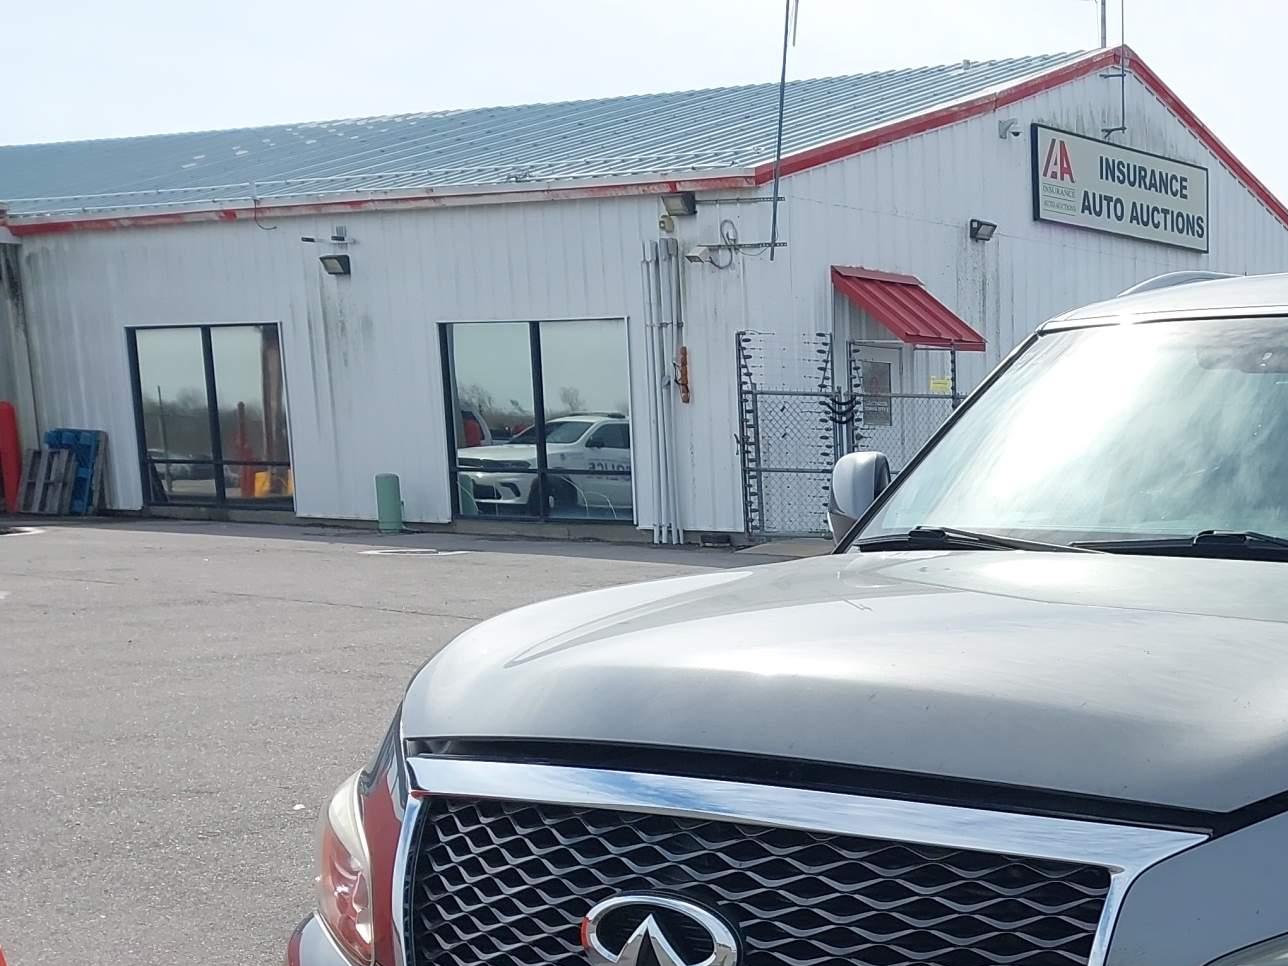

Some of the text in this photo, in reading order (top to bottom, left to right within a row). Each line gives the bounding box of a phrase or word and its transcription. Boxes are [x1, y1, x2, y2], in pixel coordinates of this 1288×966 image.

[1099, 155, 1188, 200] INSURANCE
[1081, 190, 1205, 239] AUTO AUCTIONS
